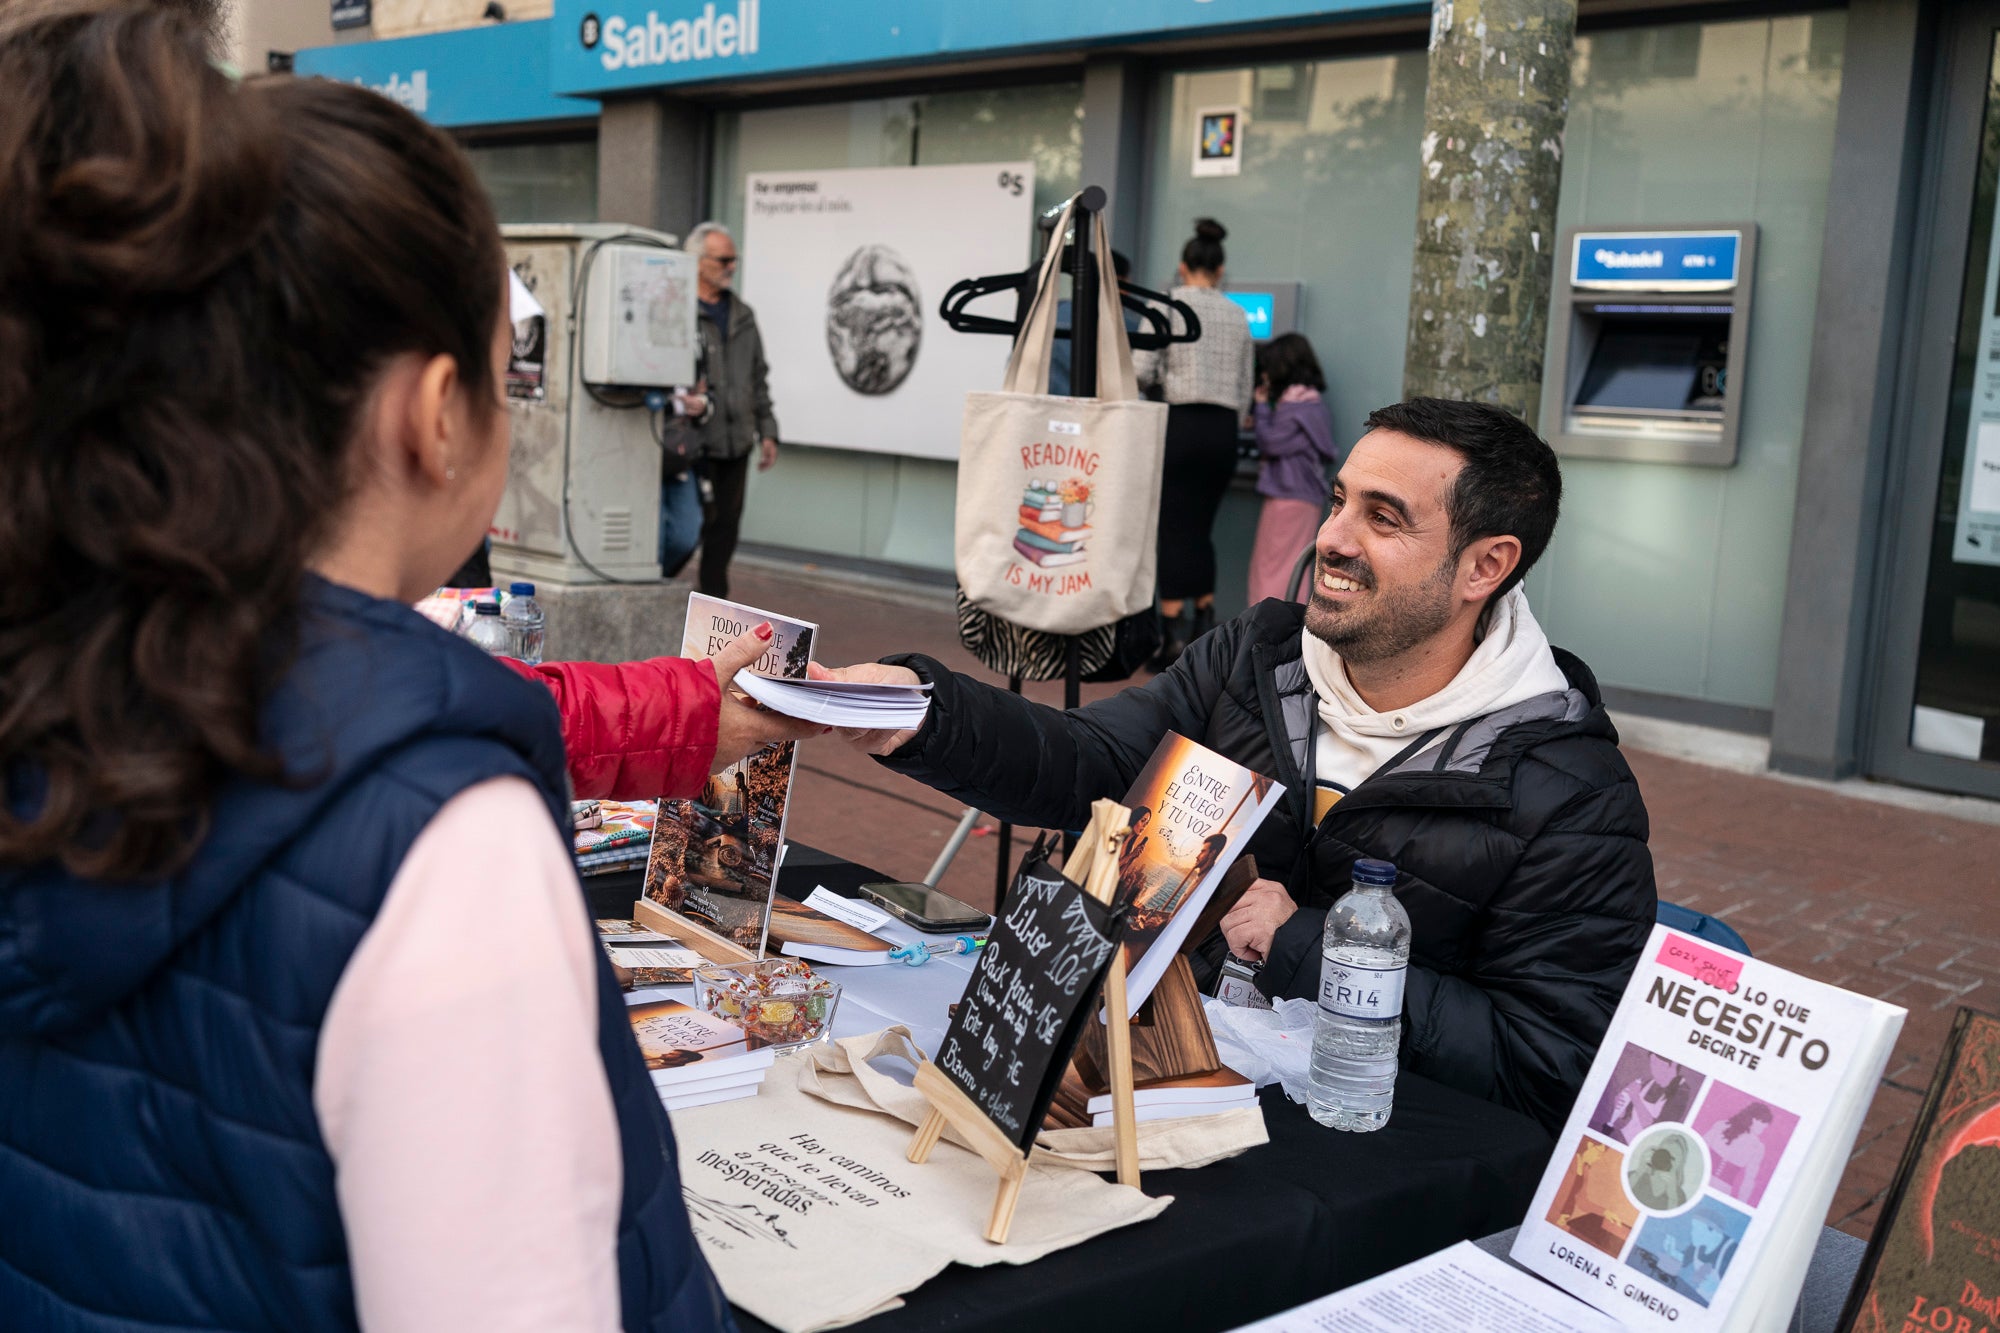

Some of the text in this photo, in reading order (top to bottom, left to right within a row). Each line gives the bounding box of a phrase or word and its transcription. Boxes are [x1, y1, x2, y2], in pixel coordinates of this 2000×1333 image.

[601, 0, 759, 71] Sabadell
[1020, 443, 1099, 476] READING
[1005, 563, 1092, 595] IS MY JAM
[712, 616, 742, 637] TODO
[1165, 782, 1224, 821] EL FUEGO
[1183, 765, 1231, 802] ENTRE
[1157, 800, 1212, 838] Y TU VOZ
[1005, 896, 1088, 996] Libro 10€
[1669, 946, 1698, 963] COZY
[981, 941, 1010, 988] Pack
[1035, 1003, 1063, 1045] 15€
[1321, 979, 1379, 1007] ERI4
[1744, 987, 1767, 1006] LO
[1773, 999, 1811, 1024] QUE
[645, 1016, 705, 1046] EL FUEGO
[668, 1016, 718, 1037] ENTRE
[962, 997, 983, 1037] Tote
[1646, 976, 1830, 1070] NECESITO
[943, 1037, 976, 1091] Bizum
[1688, 1030, 1761, 1070] DECIRTE
[696, 1149, 813, 1216] inesperadas.
[734, 1152, 839, 1206] a personas
[757, 1143, 879, 1207] que te llevan
[789, 1133, 911, 1198] Hay caminos
[1549, 1241, 1680, 1322] LORENA S. GIMENO
